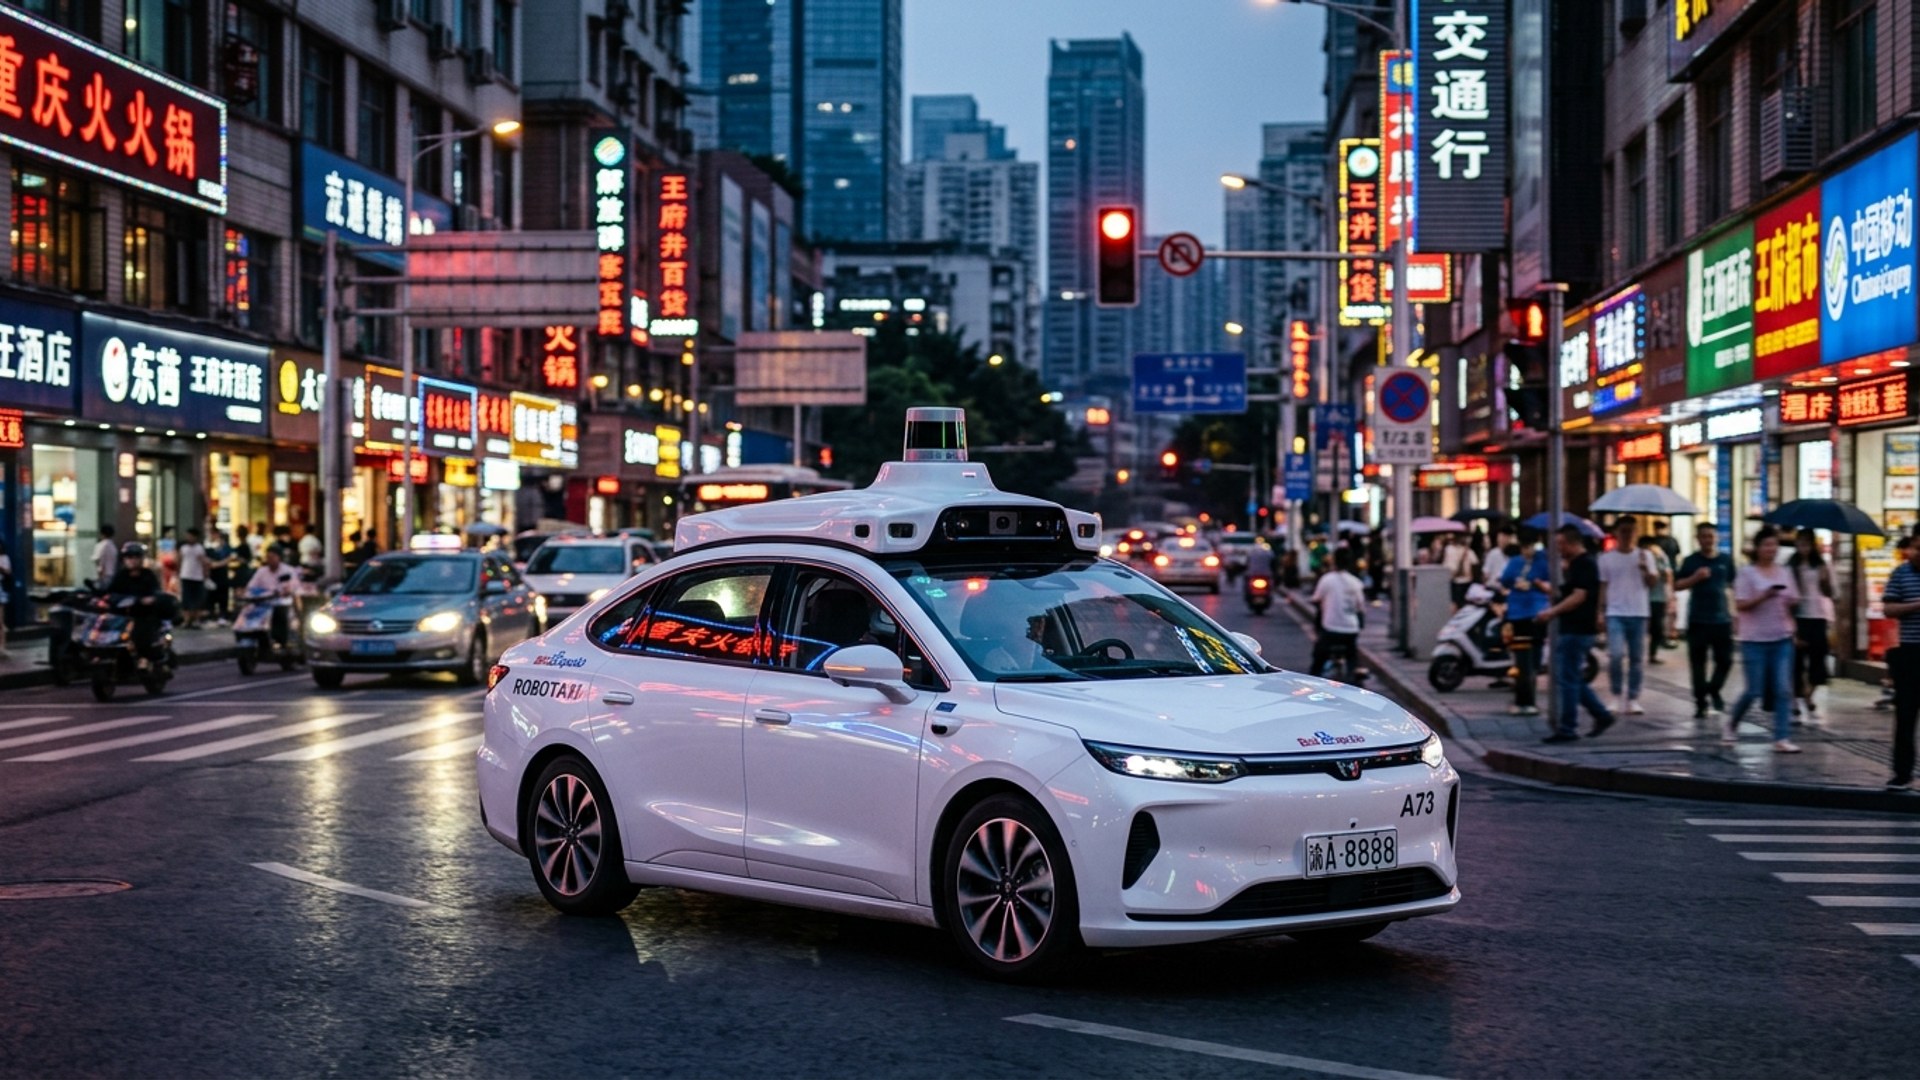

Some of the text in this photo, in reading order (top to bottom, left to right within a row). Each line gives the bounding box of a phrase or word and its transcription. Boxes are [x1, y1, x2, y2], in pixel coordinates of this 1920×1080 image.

[0, 34, 196, 180] 重庆火火锅
[1431, 10, 1490, 180] 交通行
[1851, 187, 1912, 266] 中国移动
[1400, 790, 1435, 818] A73
